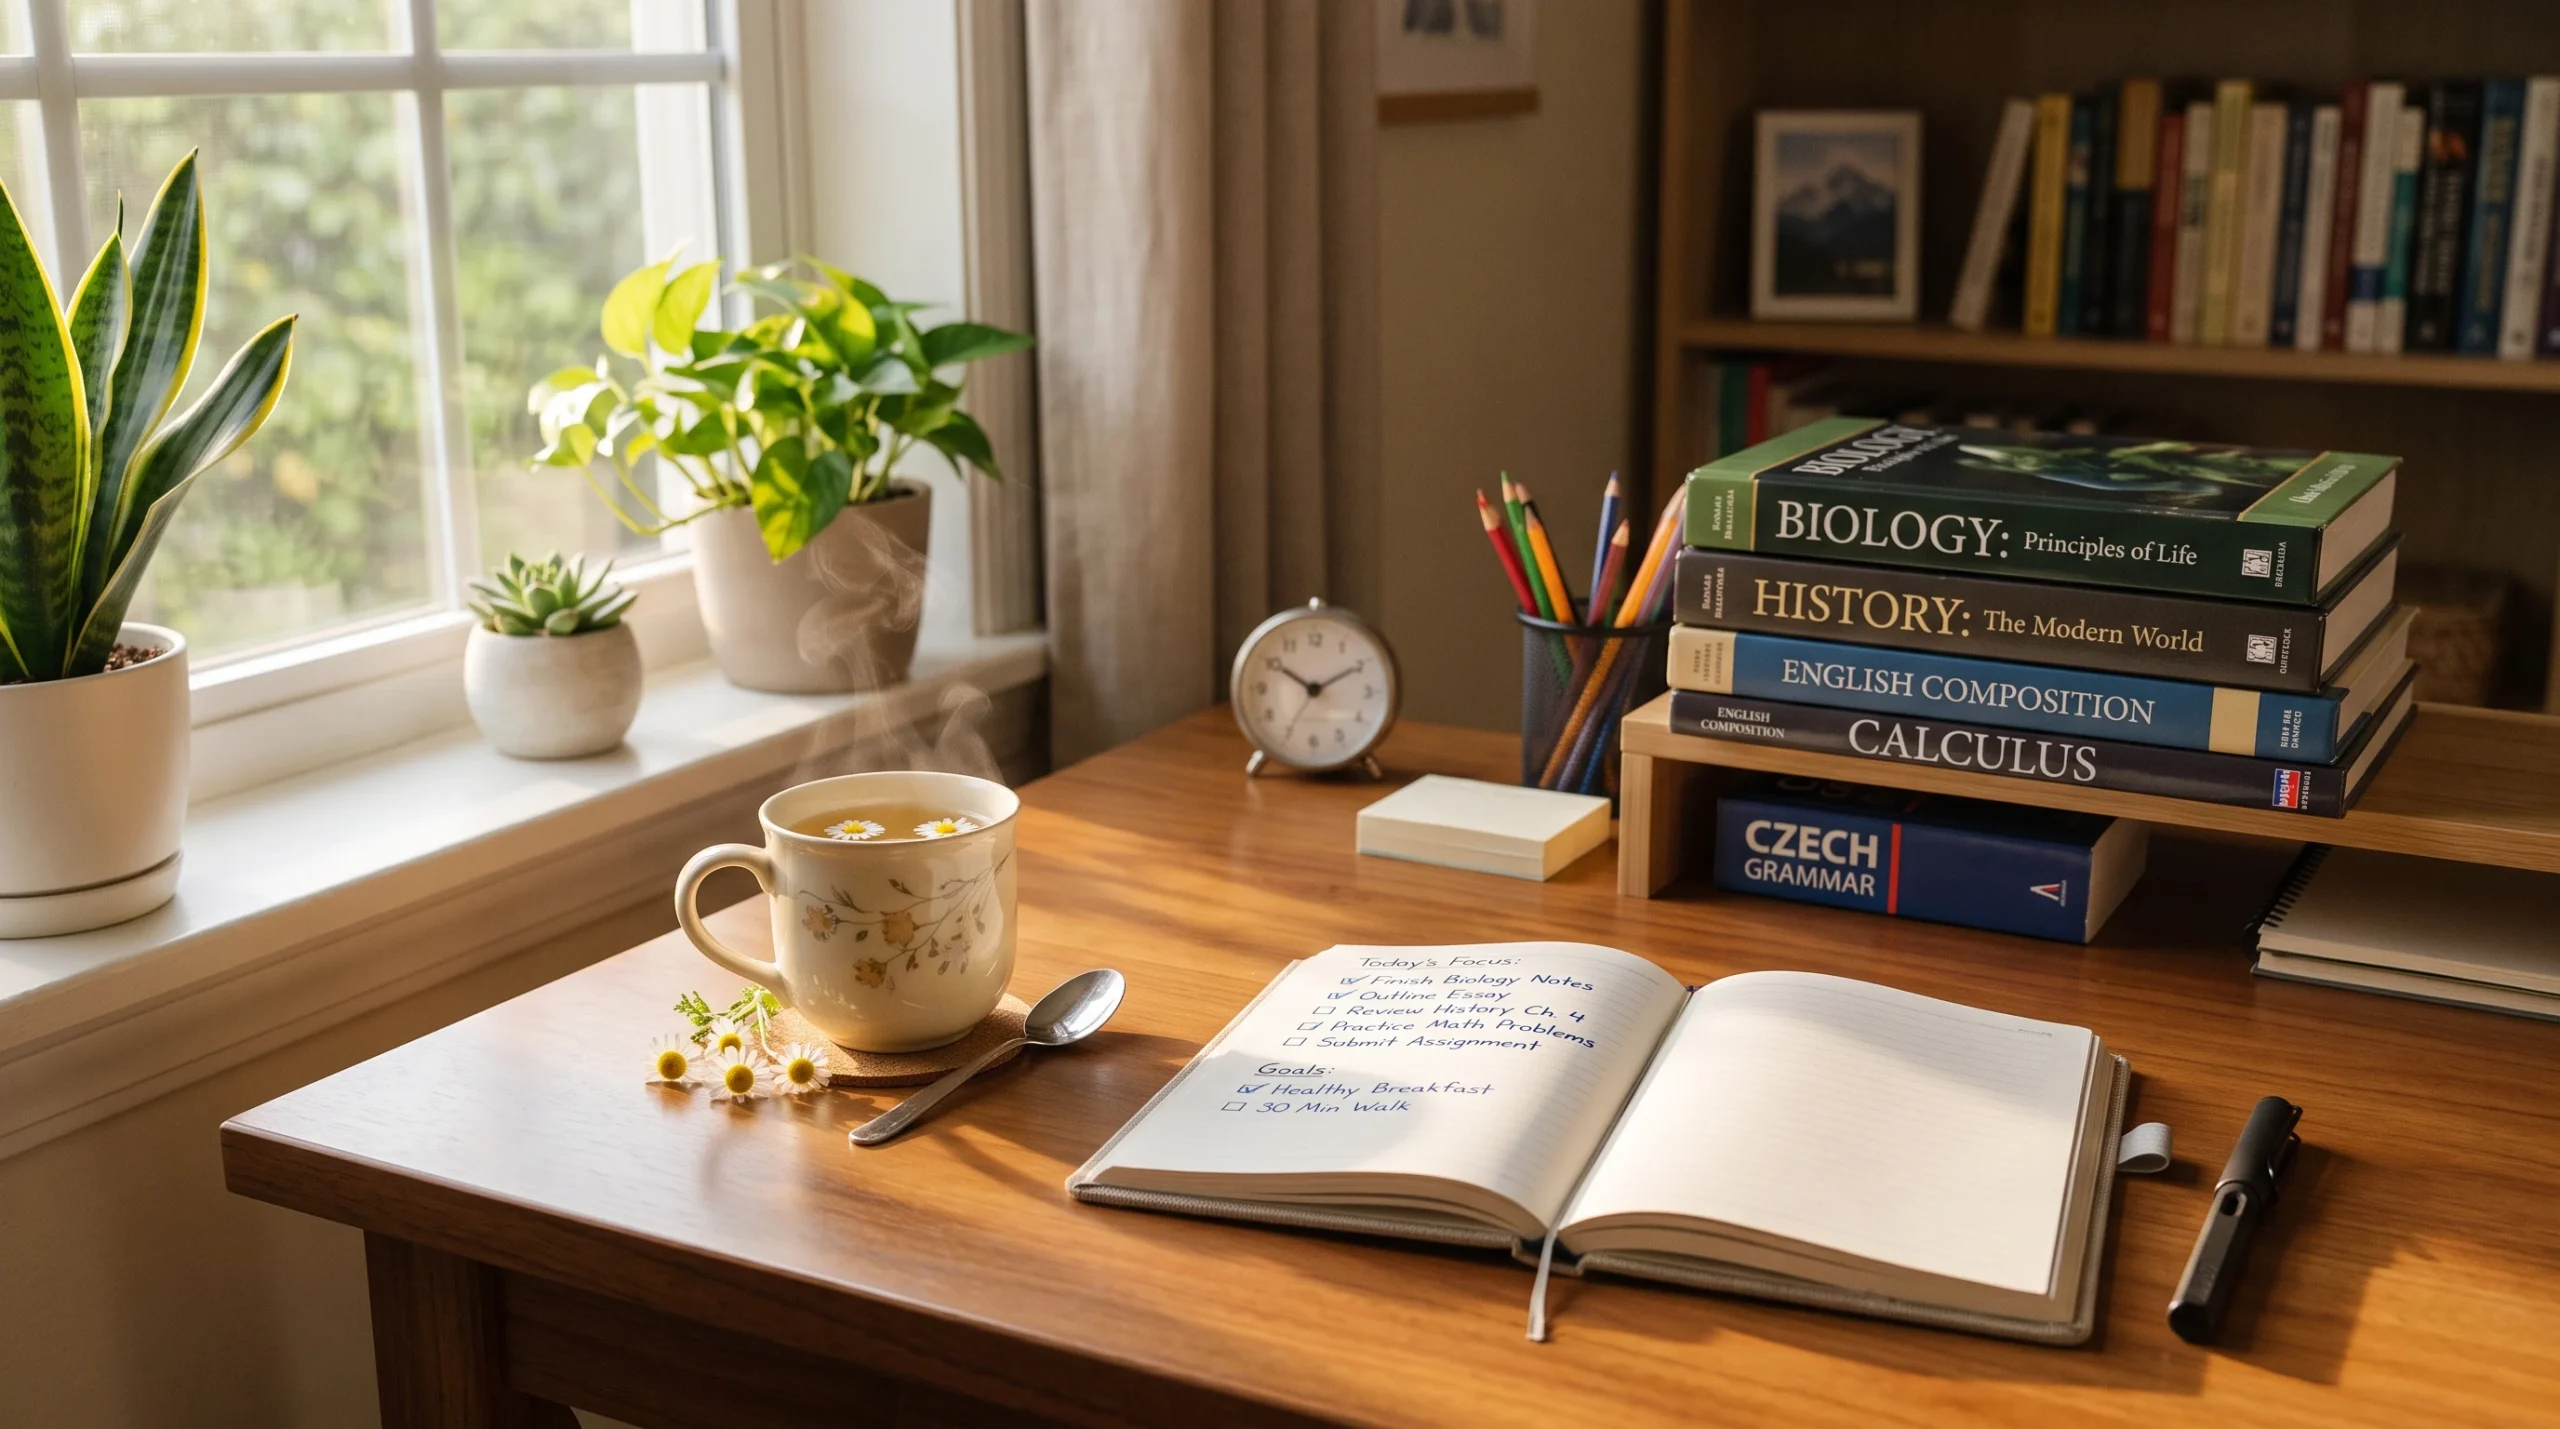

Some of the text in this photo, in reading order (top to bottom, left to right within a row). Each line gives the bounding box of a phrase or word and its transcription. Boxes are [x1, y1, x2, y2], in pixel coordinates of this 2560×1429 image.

[1775, 500, 2198, 565] BIOLOGY: Principles of Life
[1752, 579, 1971, 638] HISTORY:
[1983, 609, 2026, 634] The
[2032, 615, 2124, 645] Modern
[2131, 624, 2204, 653] World
[1283, 640, 1297, 653] 11
[1308, 632, 1323, 648] 12
[1266, 657, 1283, 671] 10
[1782, 658, 2156, 725] ENGLISH COMPOSITION
[1717, 706, 1771, 723] ENGLISH
[1700, 719, 1785, 739] COMPOSITION
[1848, 718, 2098, 782] CALCULUS
[1745, 819, 1879, 869] CZECH
[1744, 857, 1876, 897] GRAMMAR
[1360, 956, 1521, 970] Today's Focus:
[1370, 974, 1594, 991] Finish Biology Notes
[1359, 989, 1512, 1002] Outline Essay
[1346, 1003, 1586, 1023] Review History Ch. 4
[1330, 1018, 1596, 1048] Practice Math Problems
[1317, 1035, 1542, 1051] Submit Assignment
[1258, 1062, 1335, 1076] Goals:
[1271, 1081, 1495, 1099] Healthy Breakfast
[1256, 1100, 1411, 1113] 30 Min Walk
